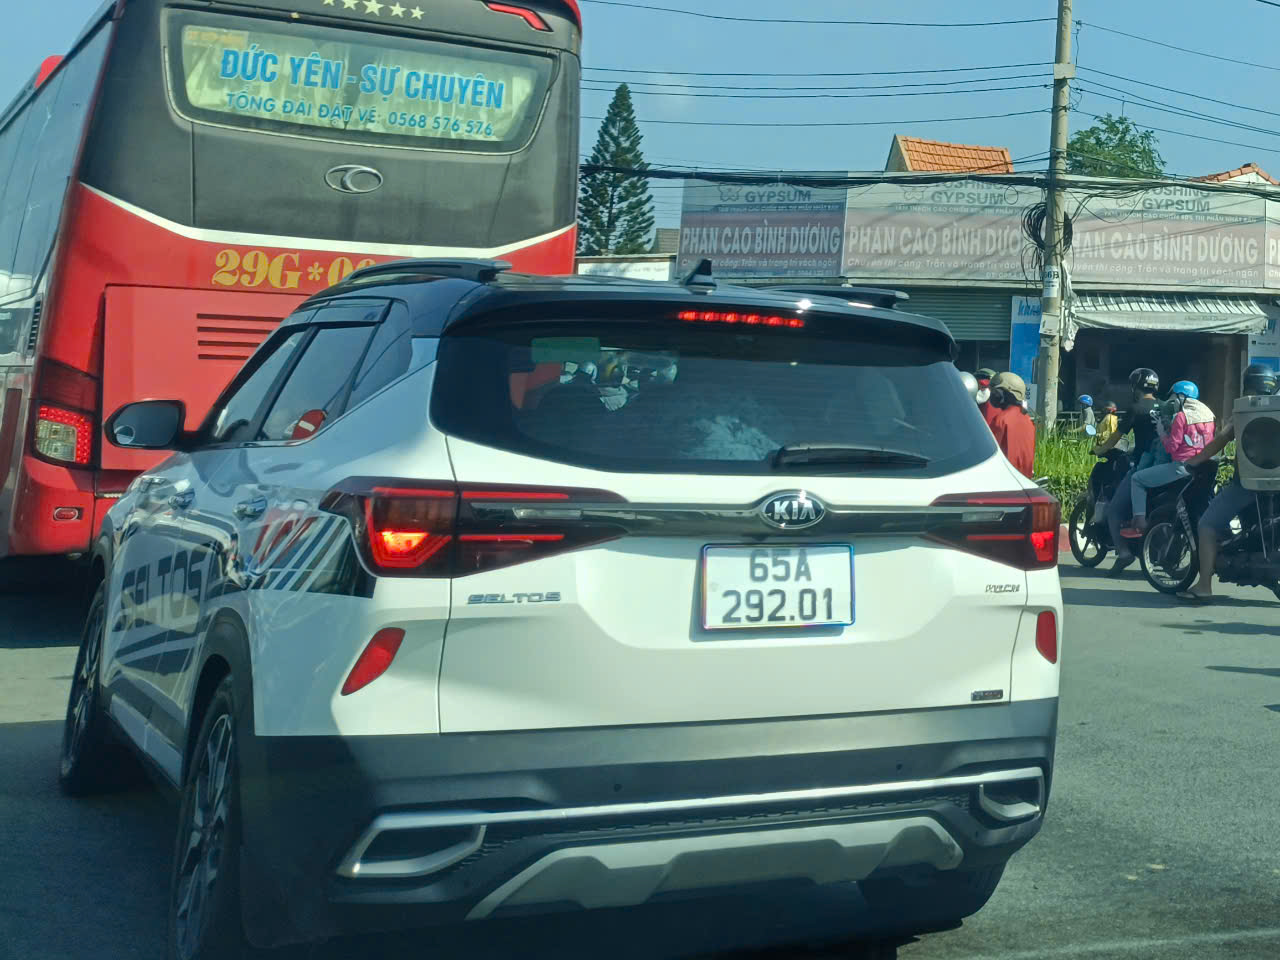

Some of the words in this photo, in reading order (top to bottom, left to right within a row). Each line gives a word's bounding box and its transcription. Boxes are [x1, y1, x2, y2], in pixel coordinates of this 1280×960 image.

[219, 43, 279, 82] ĐỨC
[289, 52, 343, 89] YÊN
[360, 64, 401, 102] SỰ
[404, 71, 504, 109] CHUYÊN
[226, 84, 276, 113] TỔNG
[388, 111, 427, 129] 0568
[431, 116, 460, 132] 576
[465, 120, 493, 137] 576
[744, 189, 812, 203] GYPSUM
[931, 190, 1004, 205] GYPSUM
[1142, 199, 1210, 213] GYPSUM
[720, 226, 751, 255] CAO
[755, 218, 787, 255] BÌNH
[789, 222, 841, 255] DƯƠNG
[899, 227, 937, 256] CAO
[1110, 231, 1150, 262] CAO
[1153, 226, 1193, 262] BÌNH
[1197, 232, 1258, 265] DƯƠNG
[773, 500, 816, 520] KIA
[749, 548, 812, 582] 65A
[467, 591, 561, 605] SELTOS
[721, 587, 833, 624] 292.01
